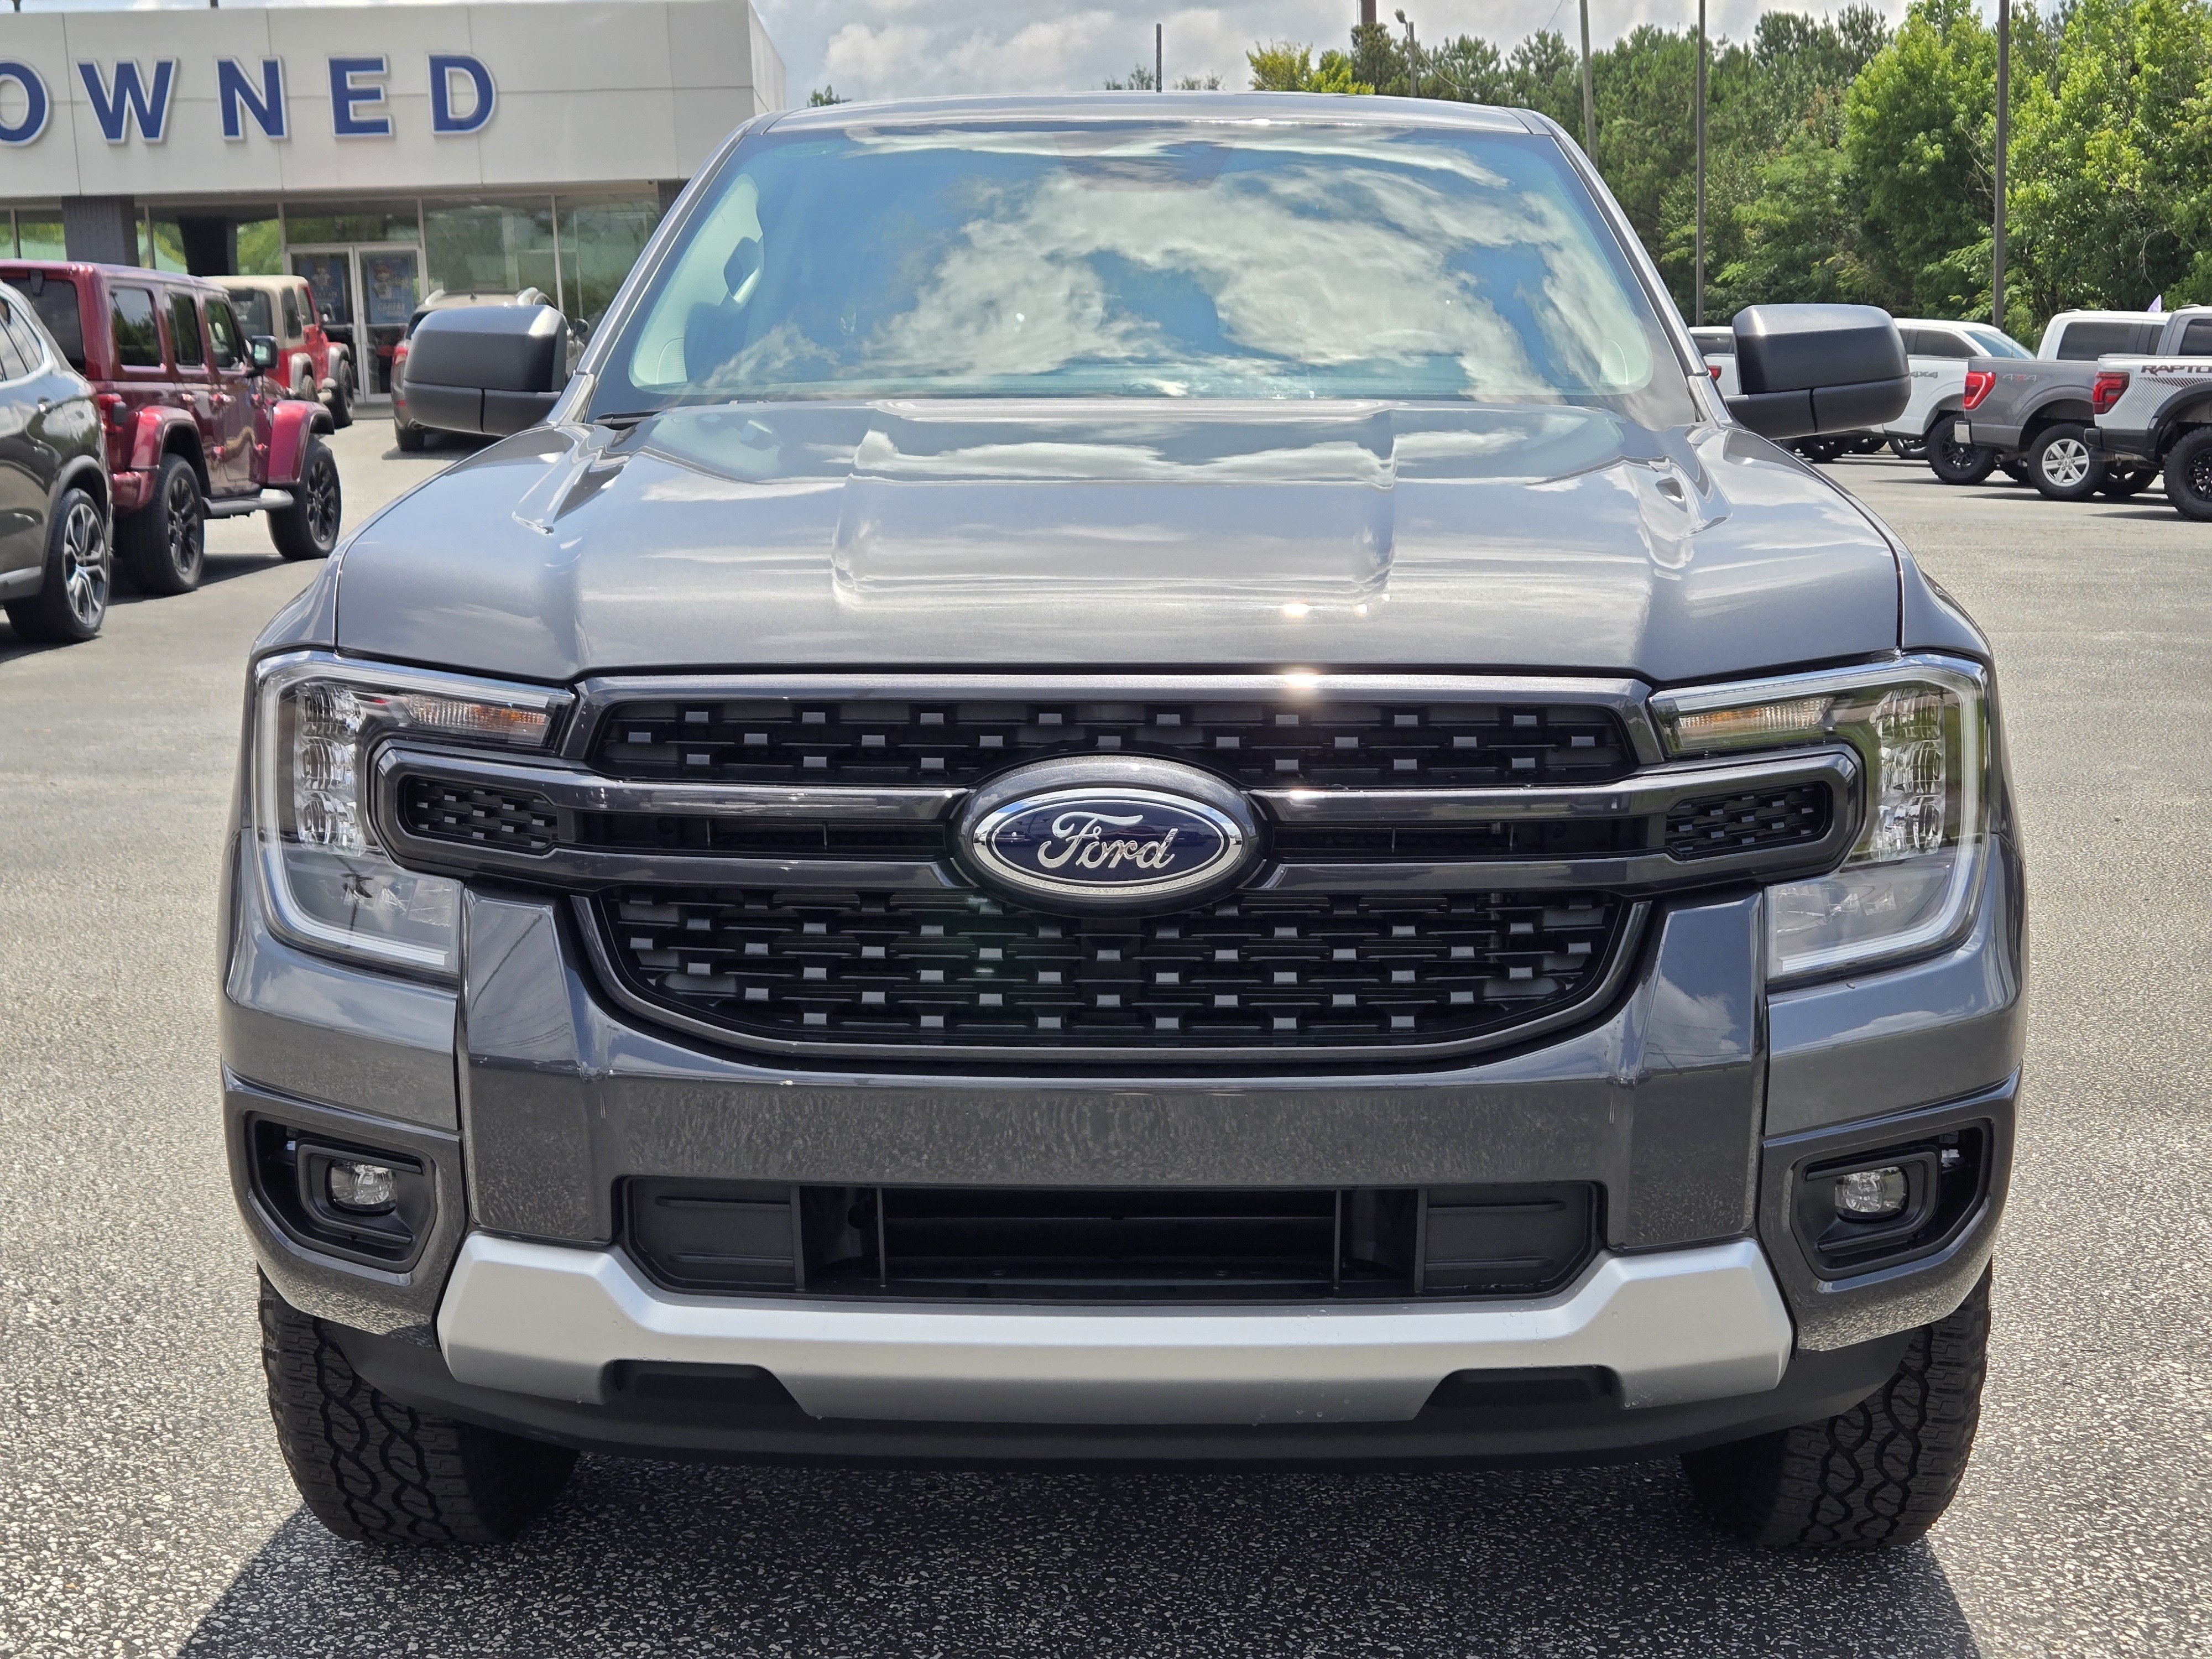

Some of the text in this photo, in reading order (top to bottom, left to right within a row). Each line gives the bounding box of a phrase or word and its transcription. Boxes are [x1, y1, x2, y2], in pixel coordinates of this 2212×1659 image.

[0, 53, 497, 147] OWNED
[2141, 365, 2212, 377] RAPTO
[1037, 811, 1179, 869] Ford
